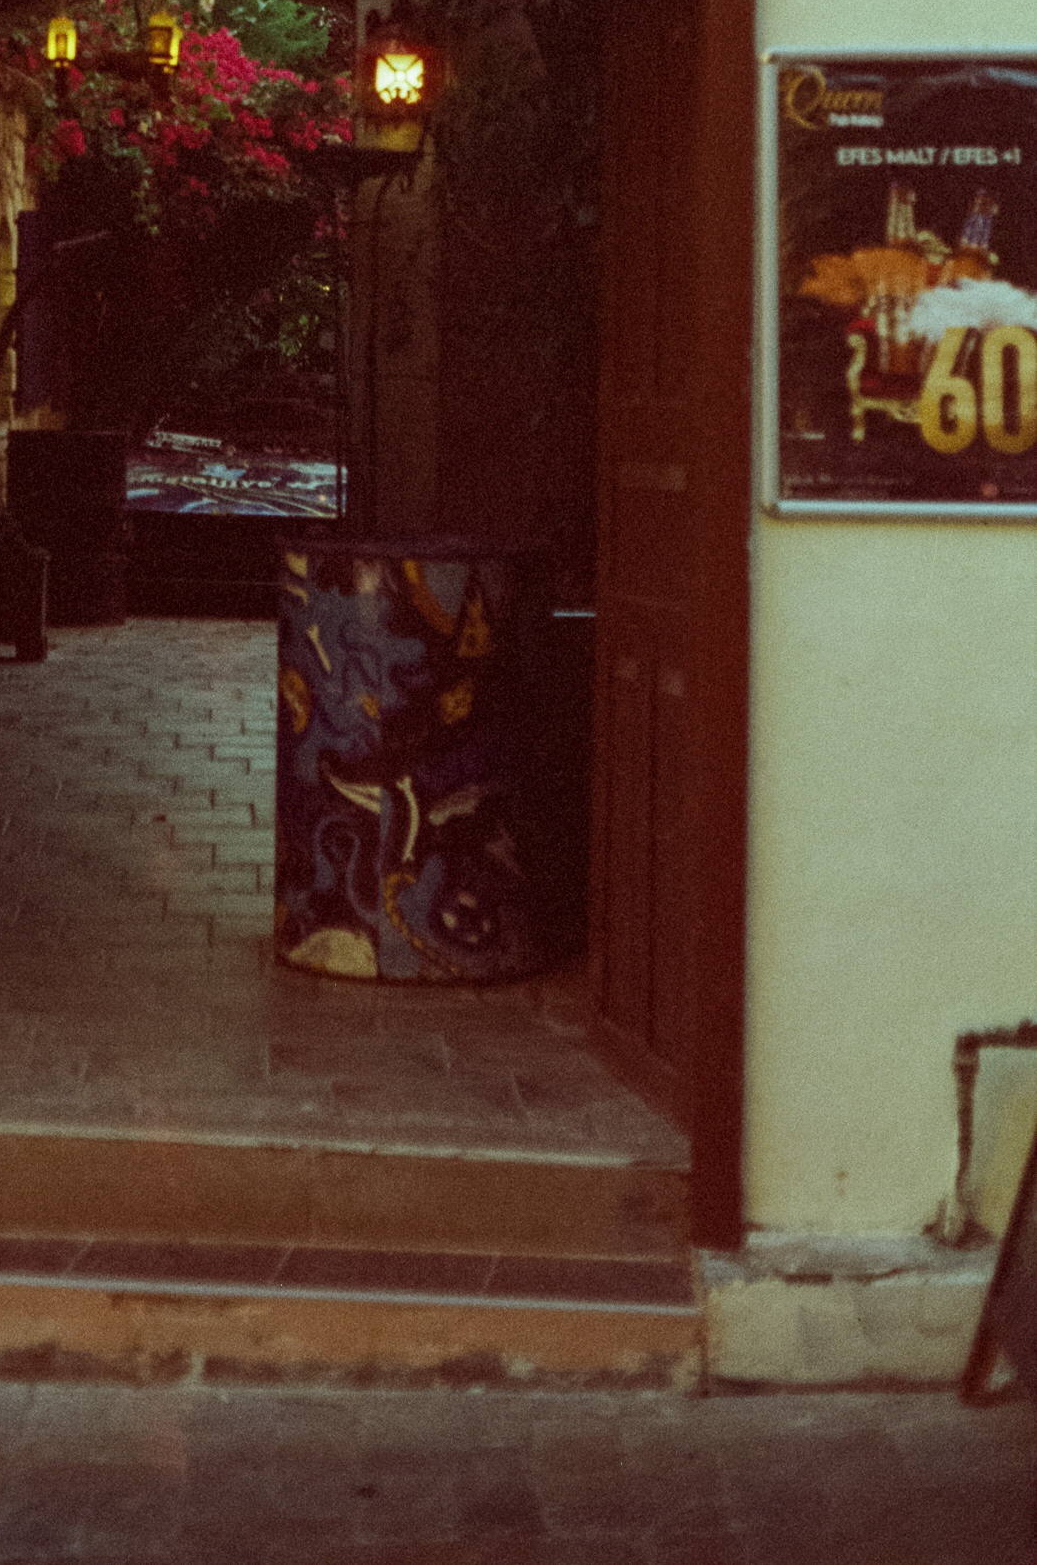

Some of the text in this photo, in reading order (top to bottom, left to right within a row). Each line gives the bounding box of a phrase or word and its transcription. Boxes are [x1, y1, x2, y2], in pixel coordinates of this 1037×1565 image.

[837, 147, 884, 166] EFES
[886, 147, 936, 165] MALT
[953, 147, 999, 166] EFES
[920, 327, 1037, 453] 60
